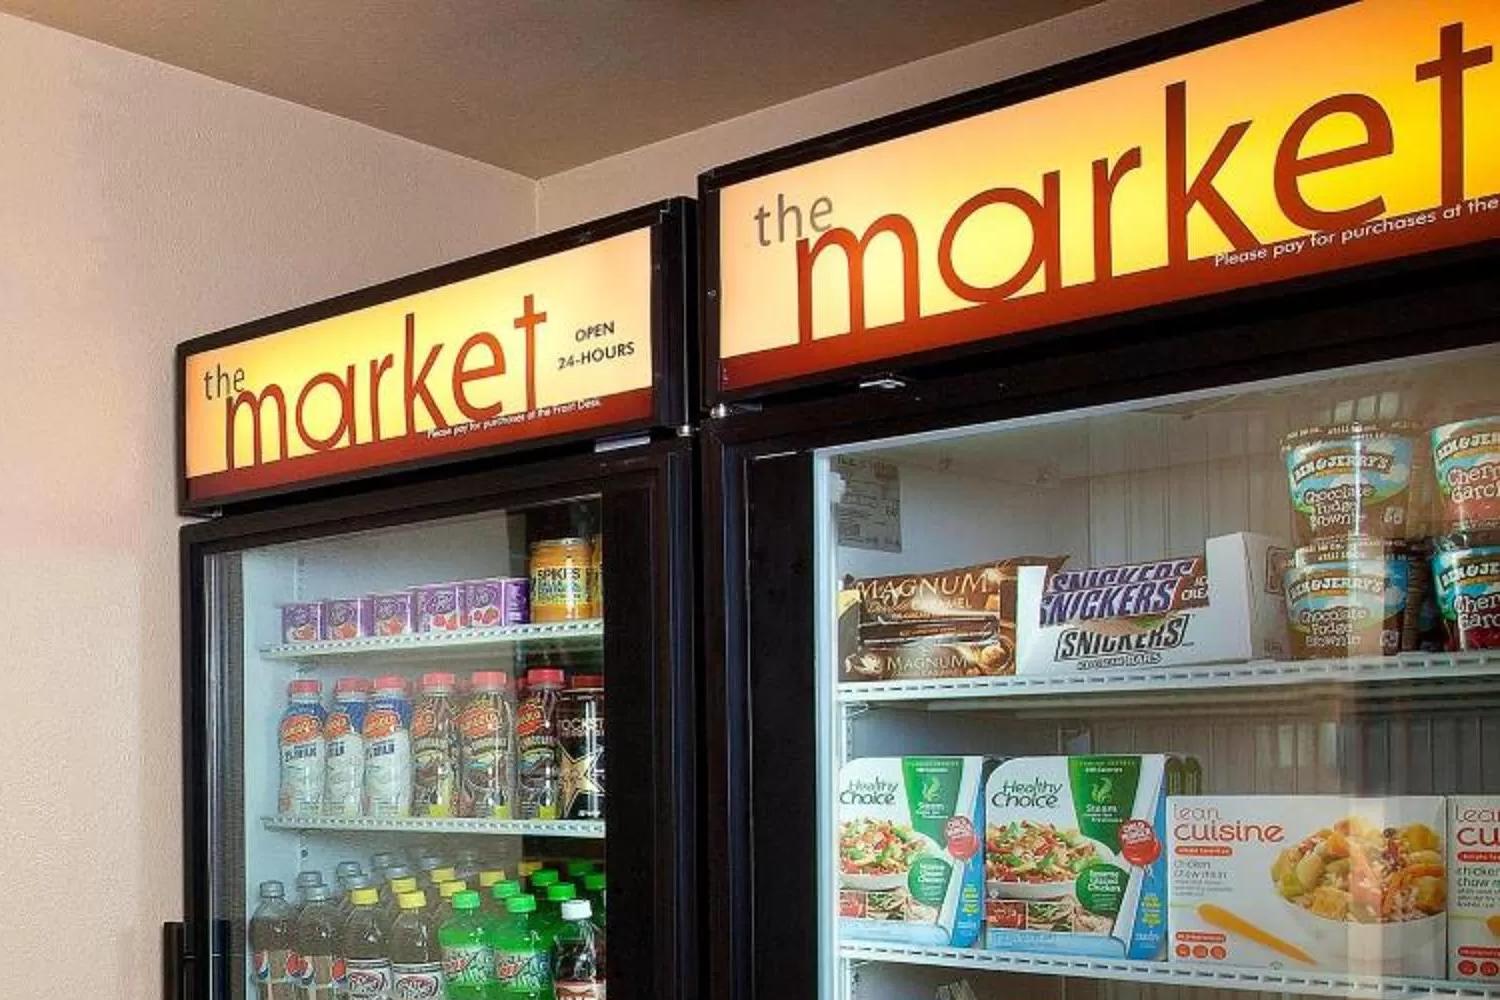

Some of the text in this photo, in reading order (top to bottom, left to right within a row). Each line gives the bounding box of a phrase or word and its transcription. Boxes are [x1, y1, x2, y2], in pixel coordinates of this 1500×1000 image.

[798, 21, 1493, 344] market
[753, 193, 834, 248] the
[1214, 198, 1500, 267] Please pay for purchases at the
[575, 320, 615, 343] OPEN
[557, 341, 636, 371] 24-HOURS
[203, 363, 246, 400] the
[226, 294, 547, 470] market
[856, 573, 991, 600] MAGNUM
[1454, 593, 1500, 614] Cher
[1458, 611, 1500, 630] Garc
[1056, 615, 1188, 661] SNICKERS
[887, 656, 970, 671] MAGNUM
[848, 776, 899, 796] Healthy
[1002, 775, 1064, 797] Healthy
[839, 789, 897, 807] Choice
[991, 789, 1059, 809] Choice
[1173, 803, 1220, 822] lean
[1172, 820, 1286, 844] cuisine
